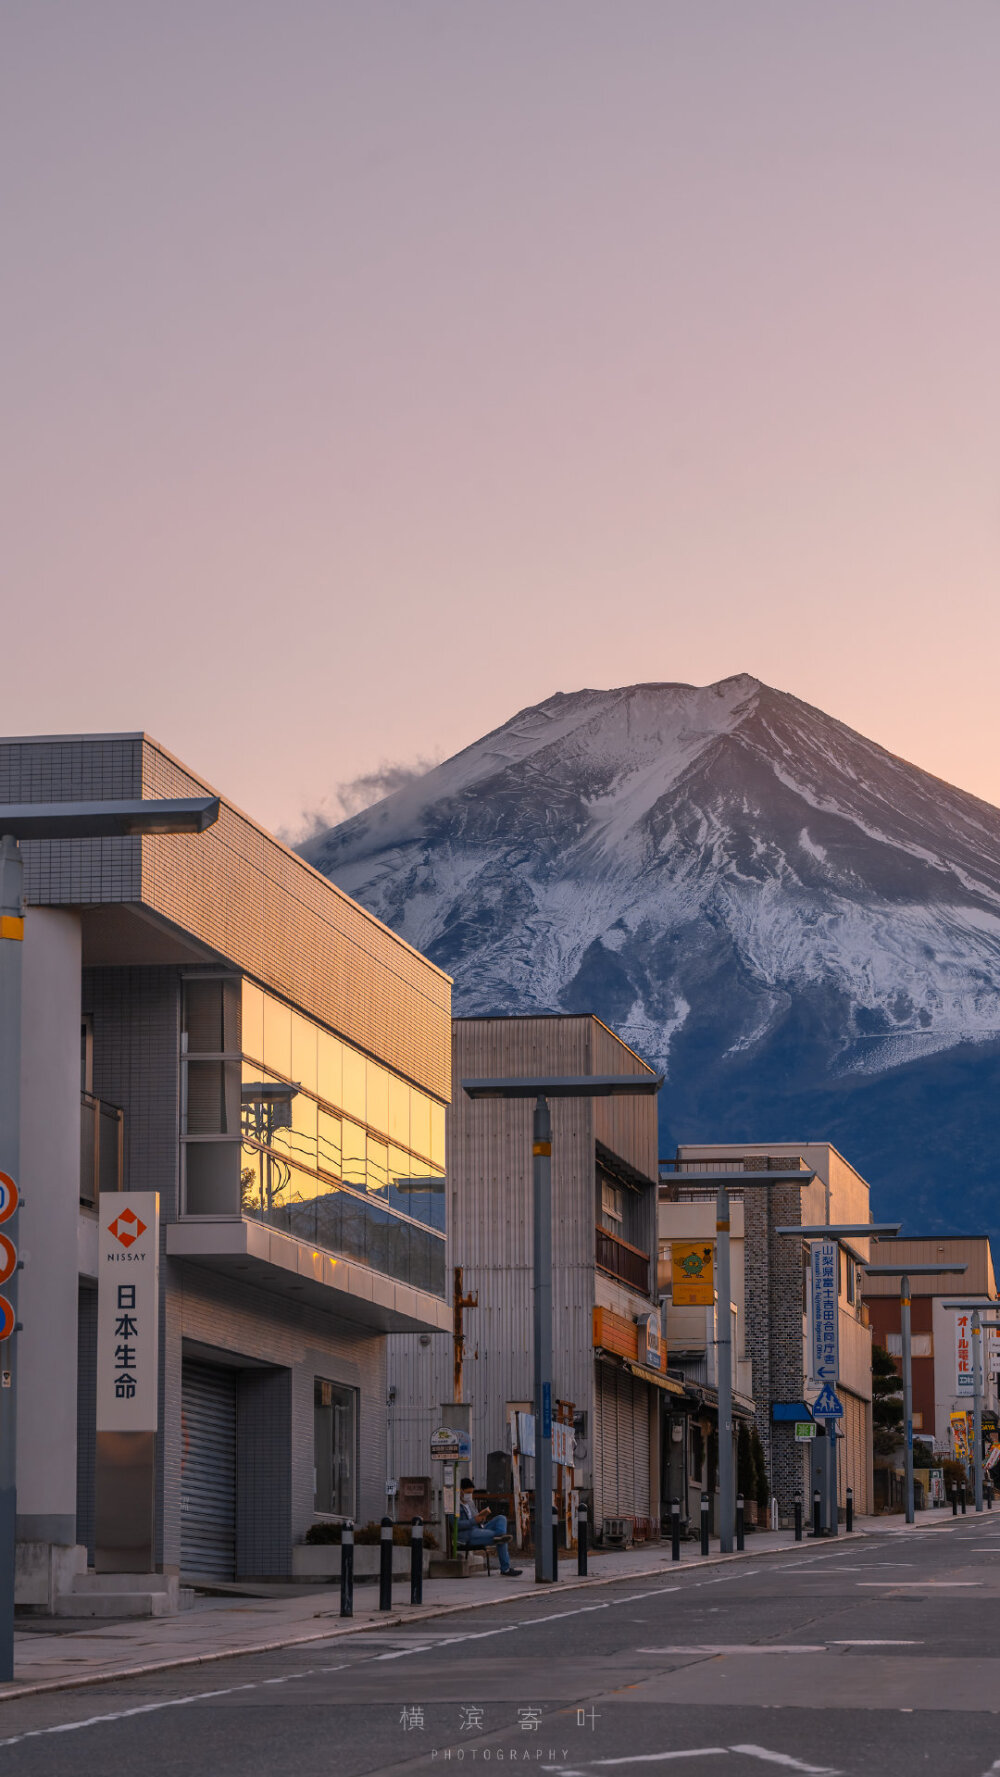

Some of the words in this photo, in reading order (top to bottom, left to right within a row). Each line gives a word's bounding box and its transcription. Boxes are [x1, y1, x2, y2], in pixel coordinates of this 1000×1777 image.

[107, 1253, 146, 1262] NISSAY
[815, 1321, 823, 1343] Regional
[822, 1245, 835, 1365] 山梨県富士吉田合同庁舎
[114, 1284, 138, 1400] 日本生命
[957, 1315, 969, 1372] オール電化
